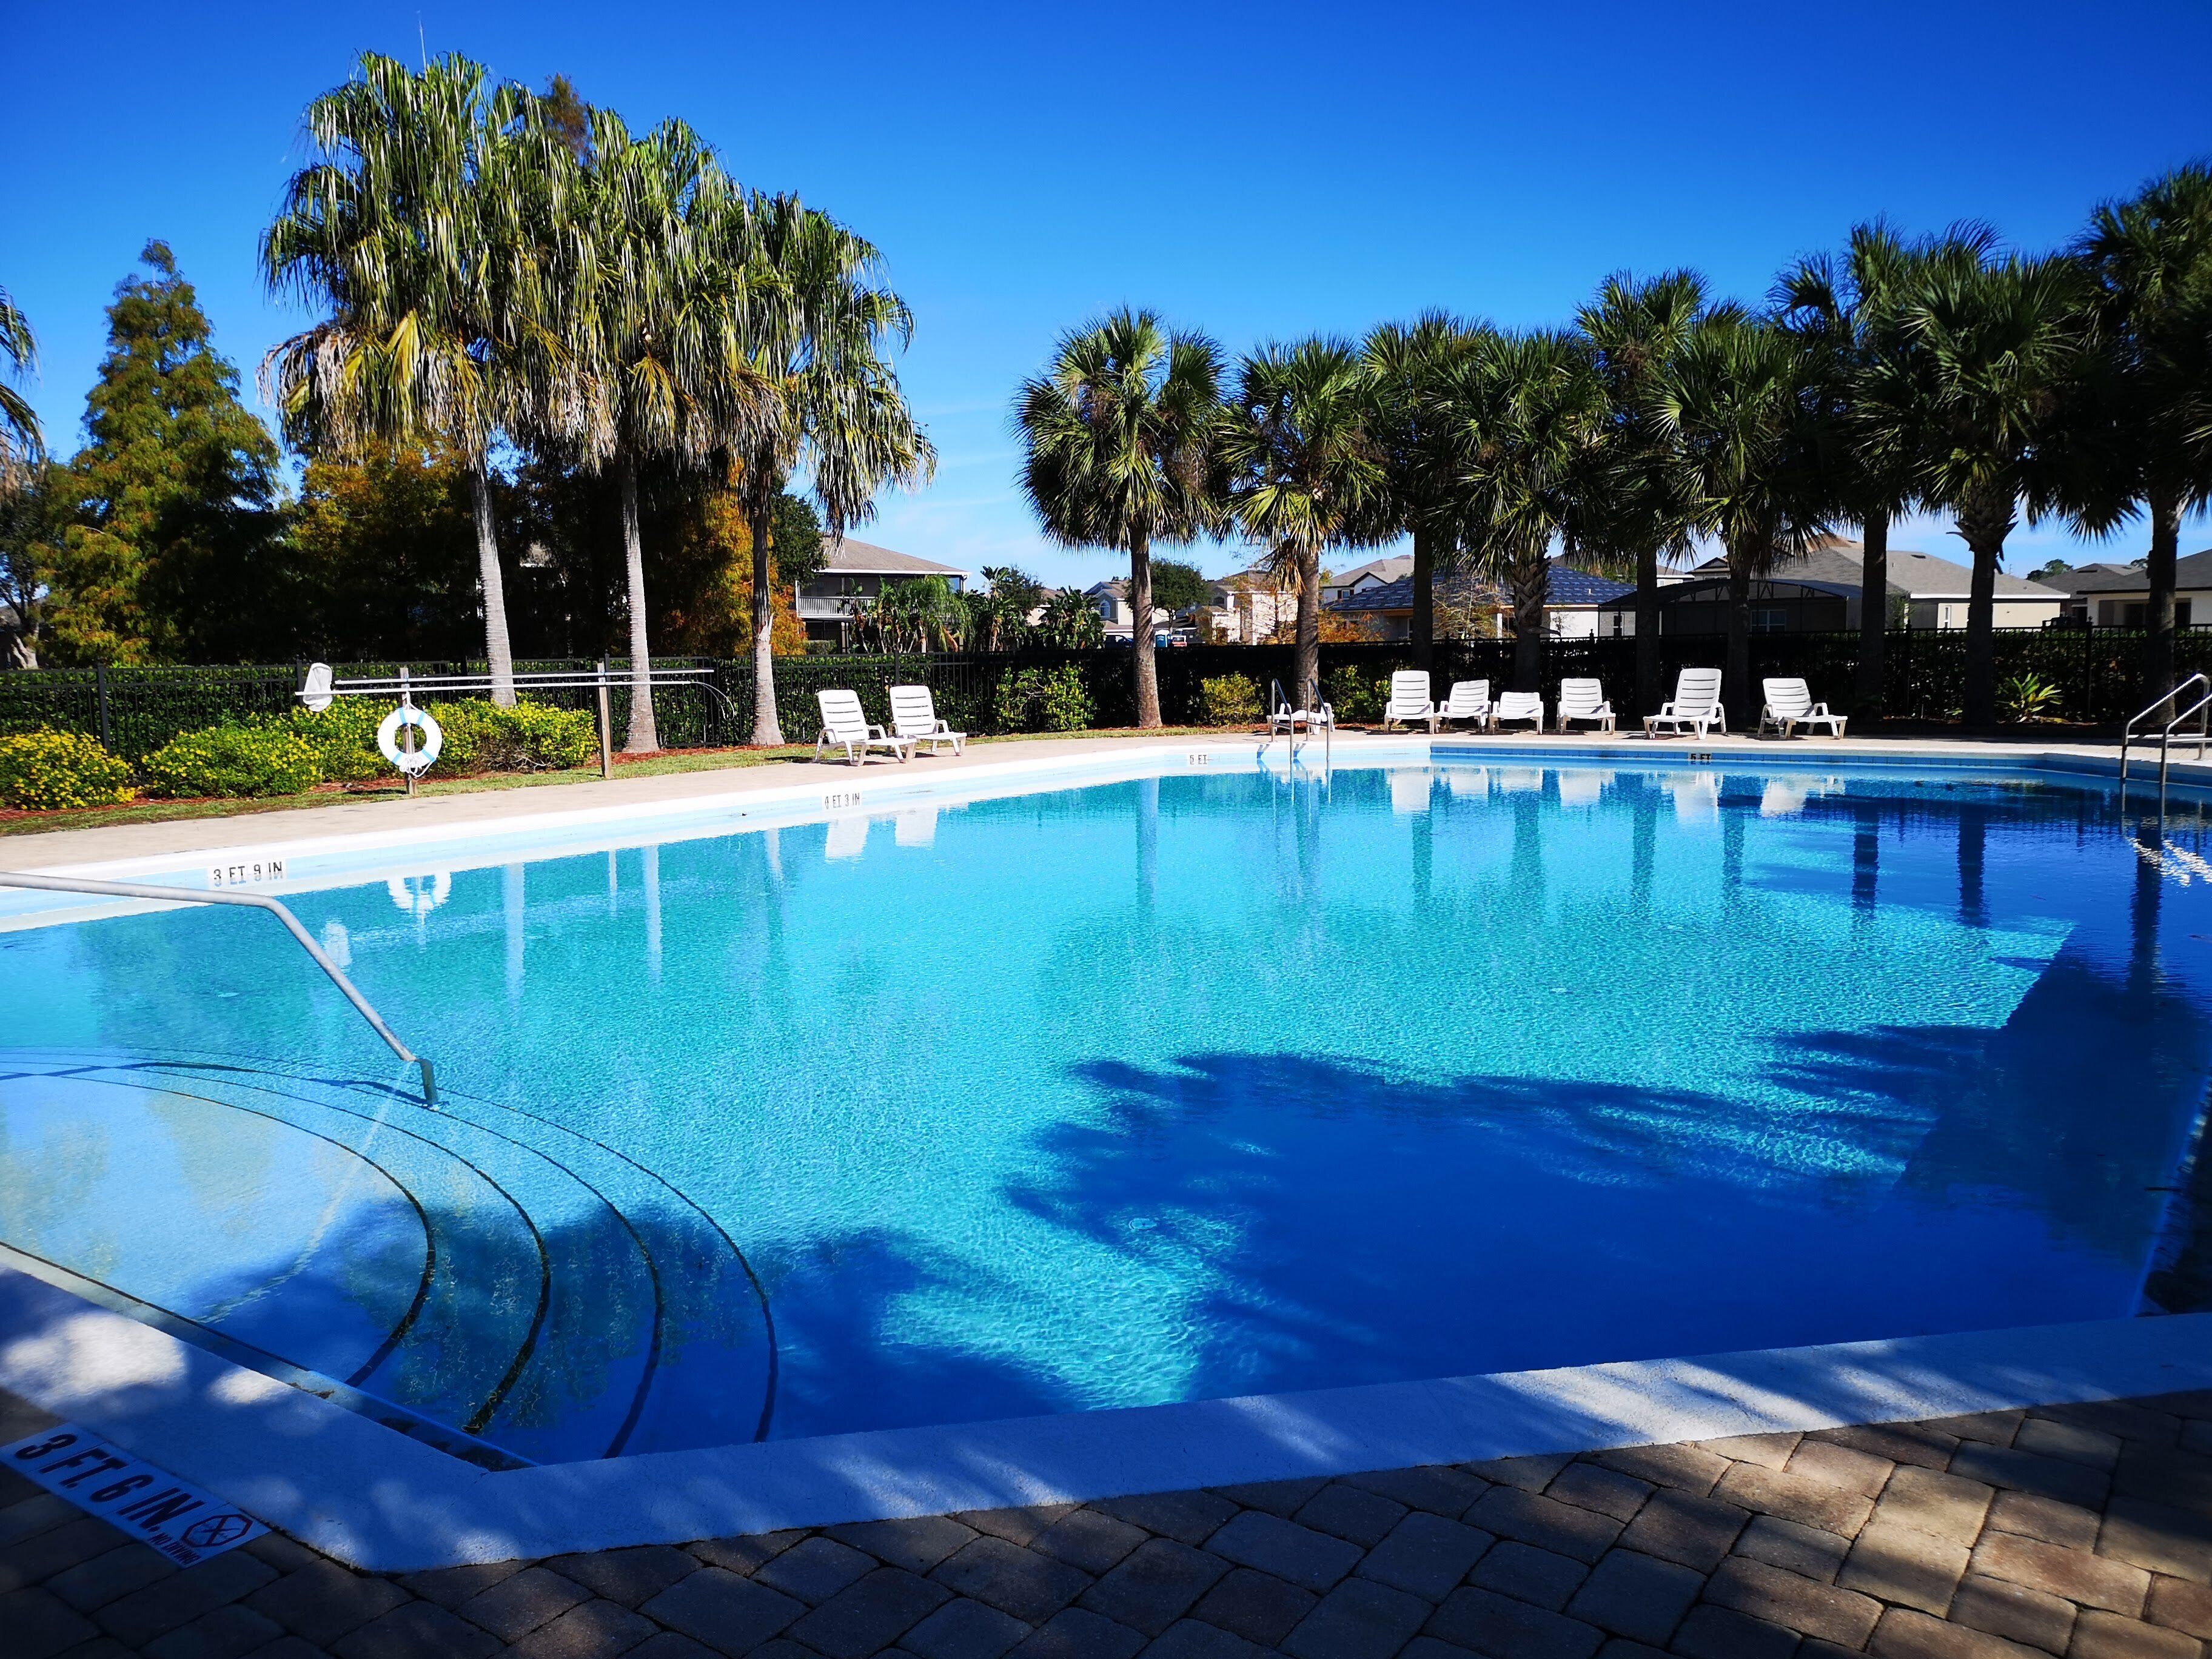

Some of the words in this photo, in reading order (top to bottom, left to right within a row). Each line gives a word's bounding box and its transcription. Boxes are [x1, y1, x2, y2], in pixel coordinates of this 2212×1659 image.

[845, 794, 849, 804] 3
[852, 793, 860, 802] IN
[213, 869, 221, 880] 3
[229, 866, 245, 878] FT
[253, 864, 261, 874] 9
[268, 861, 282, 873] IN
[15, 1433, 78, 1460] 3
[38, 1448, 130, 1489] FT.
[89, 1475, 154, 1503] 6
[117, 1487, 205, 1533] IN.
[149, 1532, 172, 1545] NO
